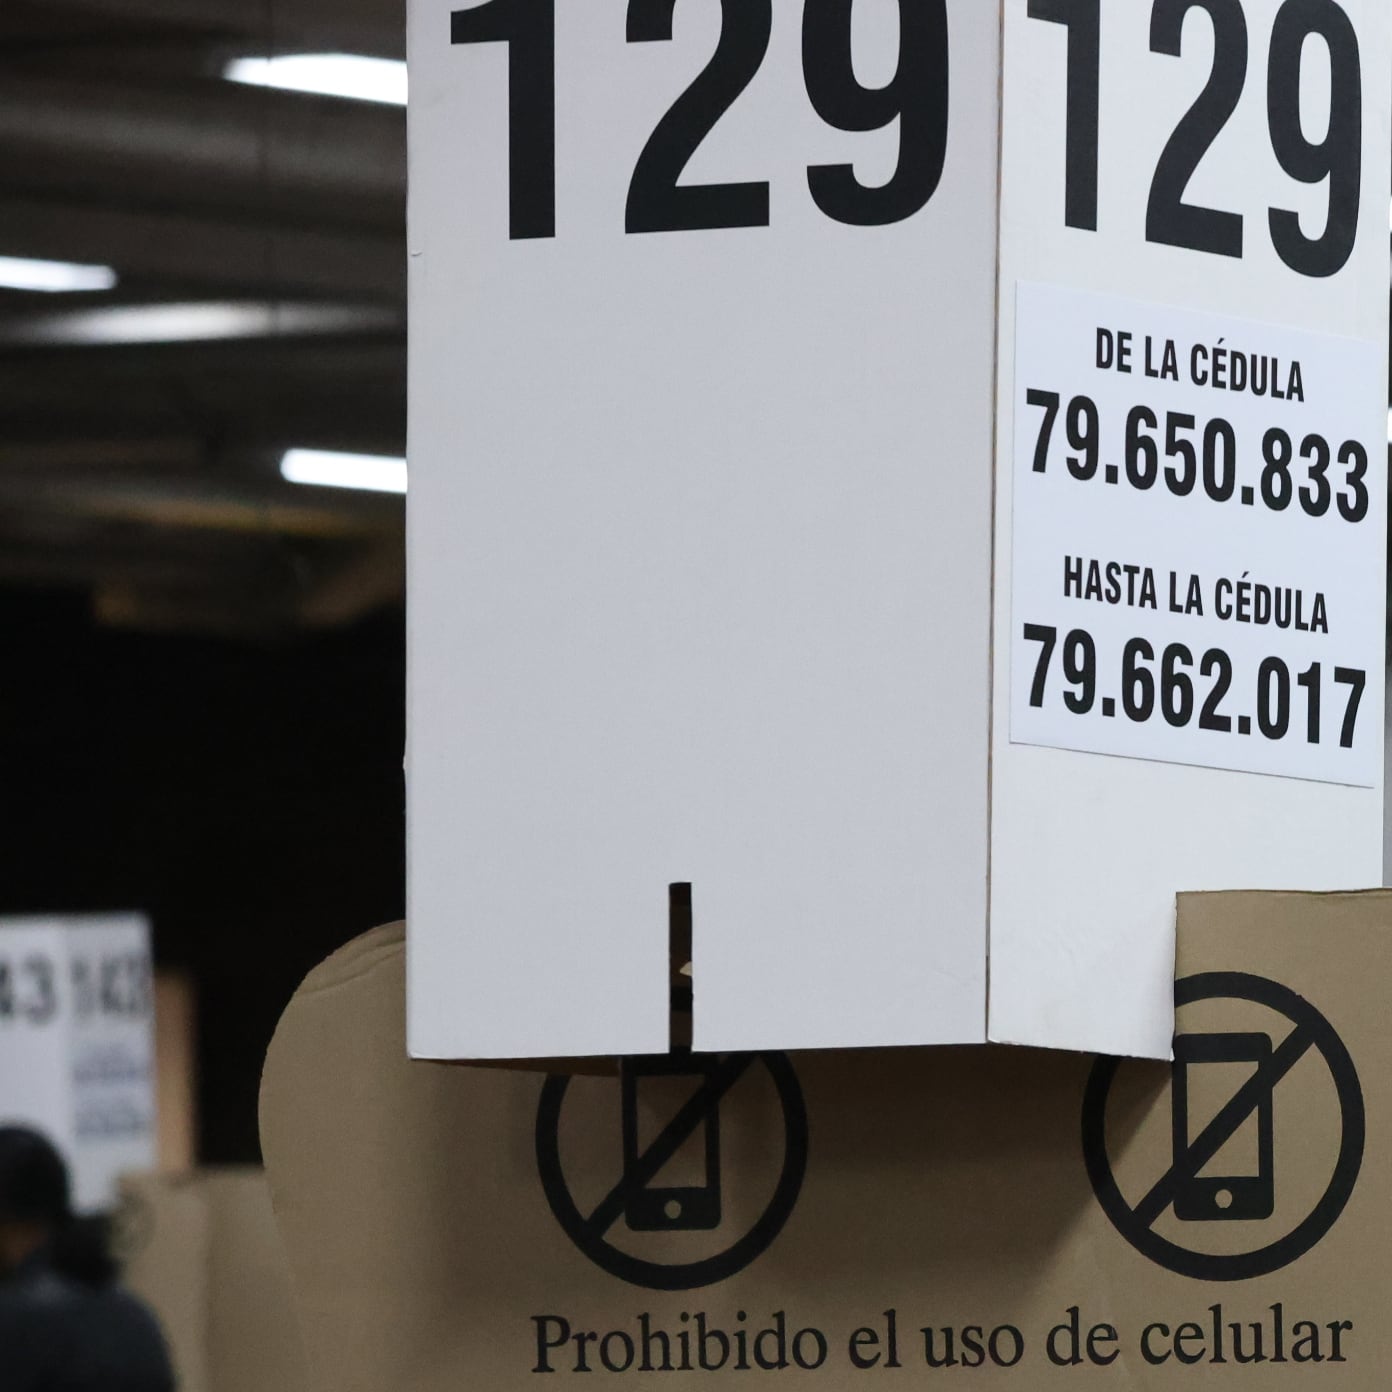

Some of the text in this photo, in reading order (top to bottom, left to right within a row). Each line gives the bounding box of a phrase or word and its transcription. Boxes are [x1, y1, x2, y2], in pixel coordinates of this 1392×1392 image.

[450, 0, 949, 241] 129
[1027, 0, 1362, 278] 129
[1096, 327, 1305, 403] DE LA CÉDULA
[1026, 388, 1369, 523] 79.650.833
[1064, 555, 1329, 634] HASTA LA CÉDULA
[1023, 622, 1366, 749] 79.662.017
[530, 1302, 1354, 1373] Prohibido el uso de celular
